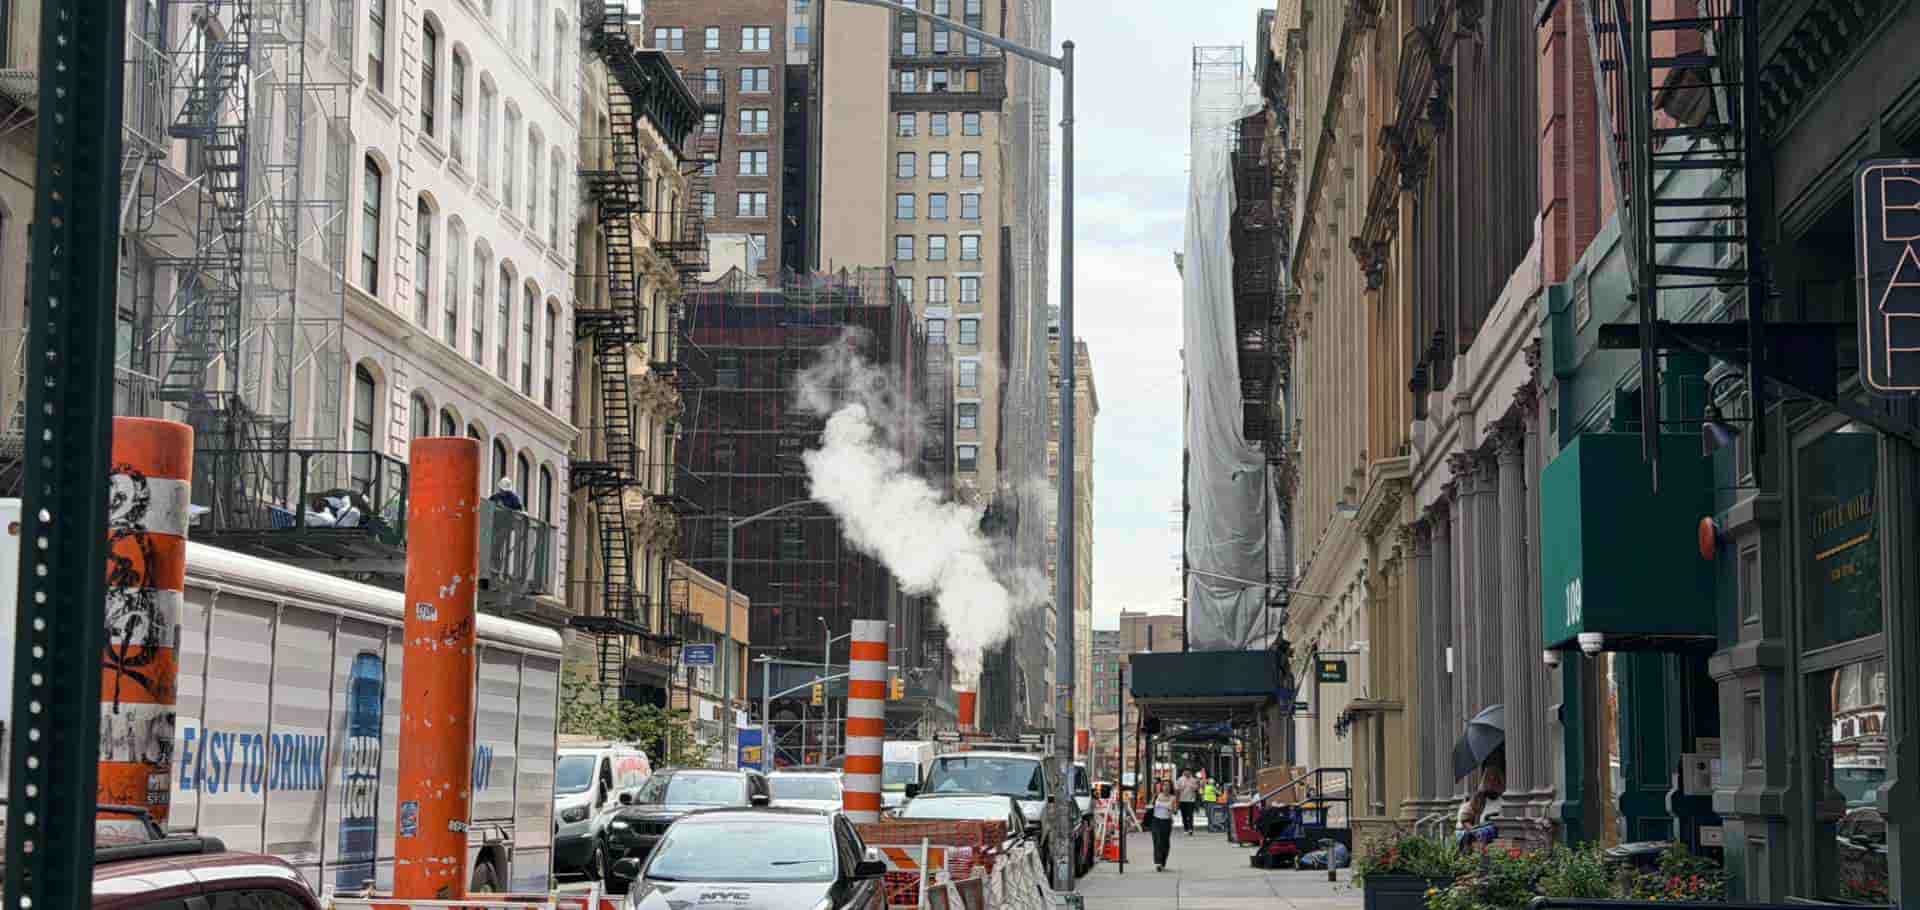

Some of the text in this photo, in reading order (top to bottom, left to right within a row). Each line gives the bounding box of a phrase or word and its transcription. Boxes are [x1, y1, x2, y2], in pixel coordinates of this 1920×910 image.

[1566, 577, 1582, 627] 109
[180, 727, 235, 794] EASY
[239, 733, 265, 794] TO
[269, 733, 325, 791] DRINK
[350, 735, 380, 774] BUD
